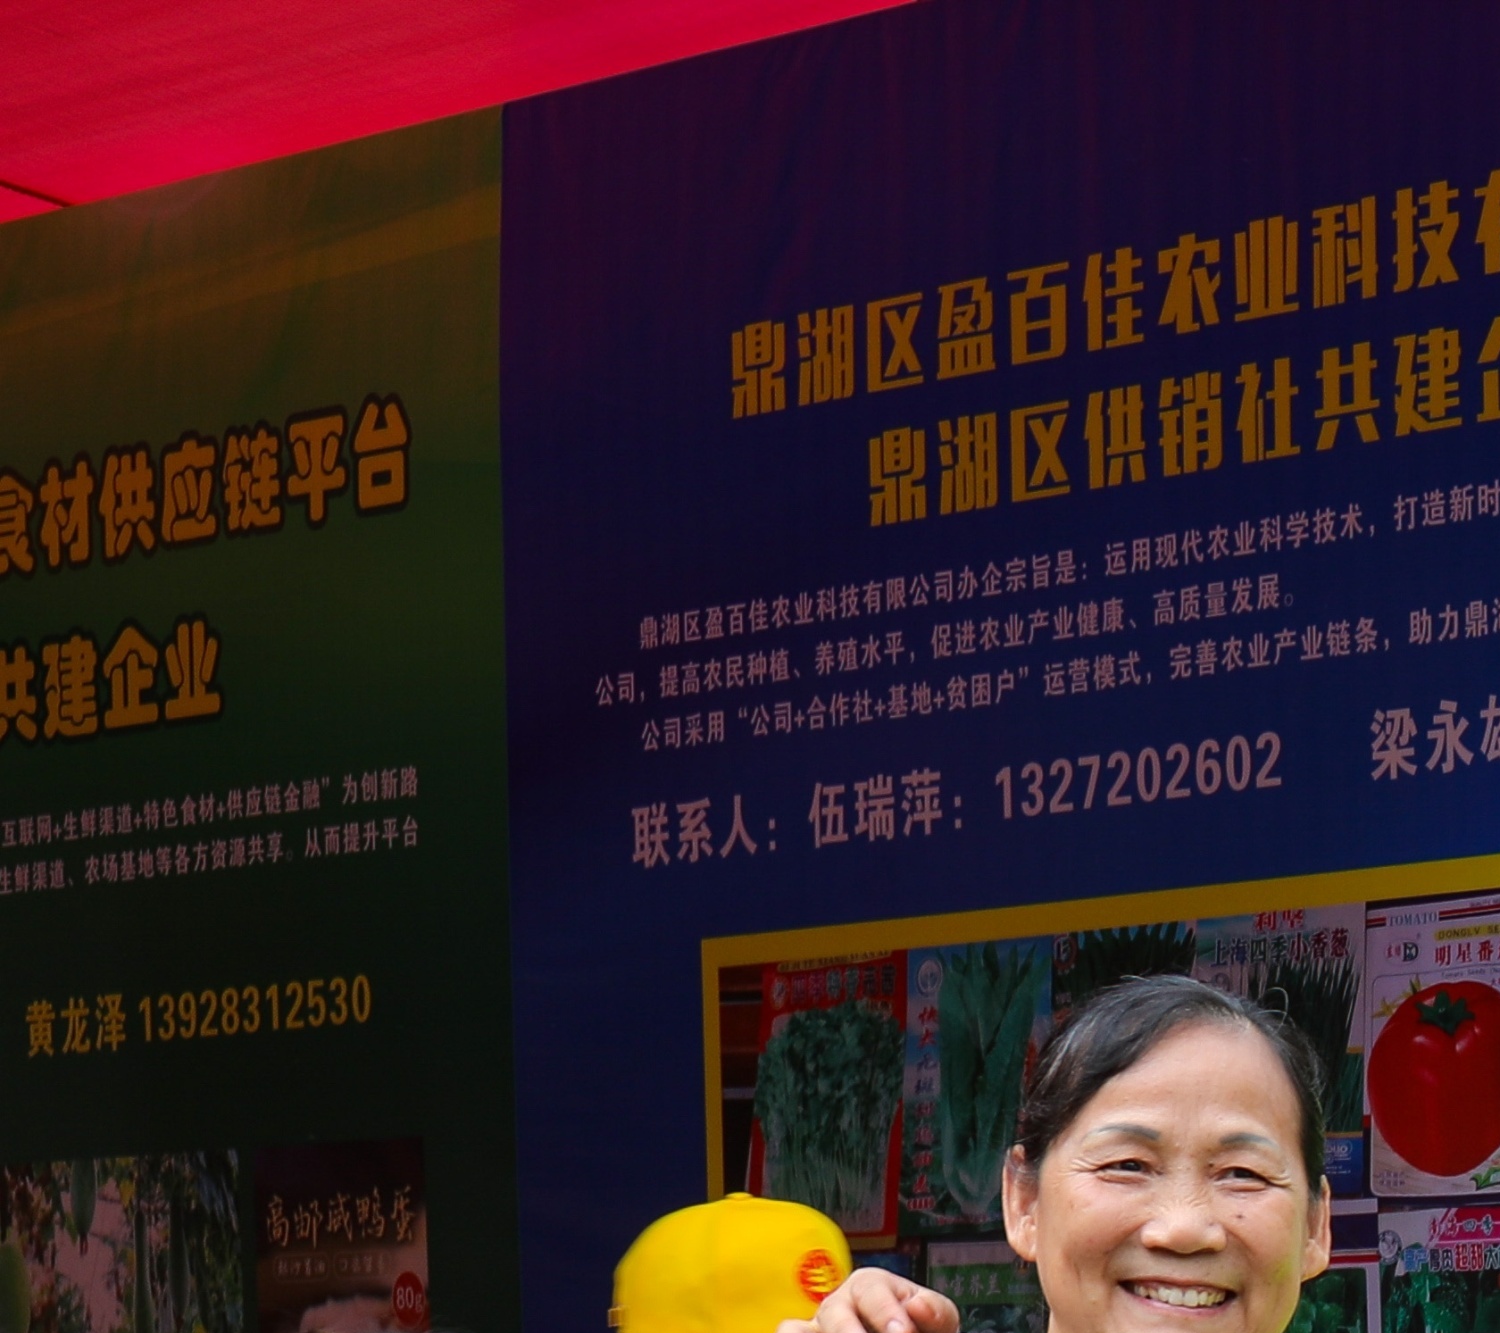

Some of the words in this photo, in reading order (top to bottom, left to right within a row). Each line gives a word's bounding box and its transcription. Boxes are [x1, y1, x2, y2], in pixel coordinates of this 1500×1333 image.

[0, 400, 409, 574] 食材供应链平台
[0, 618, 223, 741] 共建企业
[1210, 928, 1351, 967] 上海四季小香葱
[1389, 911, 1437, 927] TOMATO
[25, 992, 127, 1060] 黄龙泽
[138, 972, 374, 1042] 13928312530
